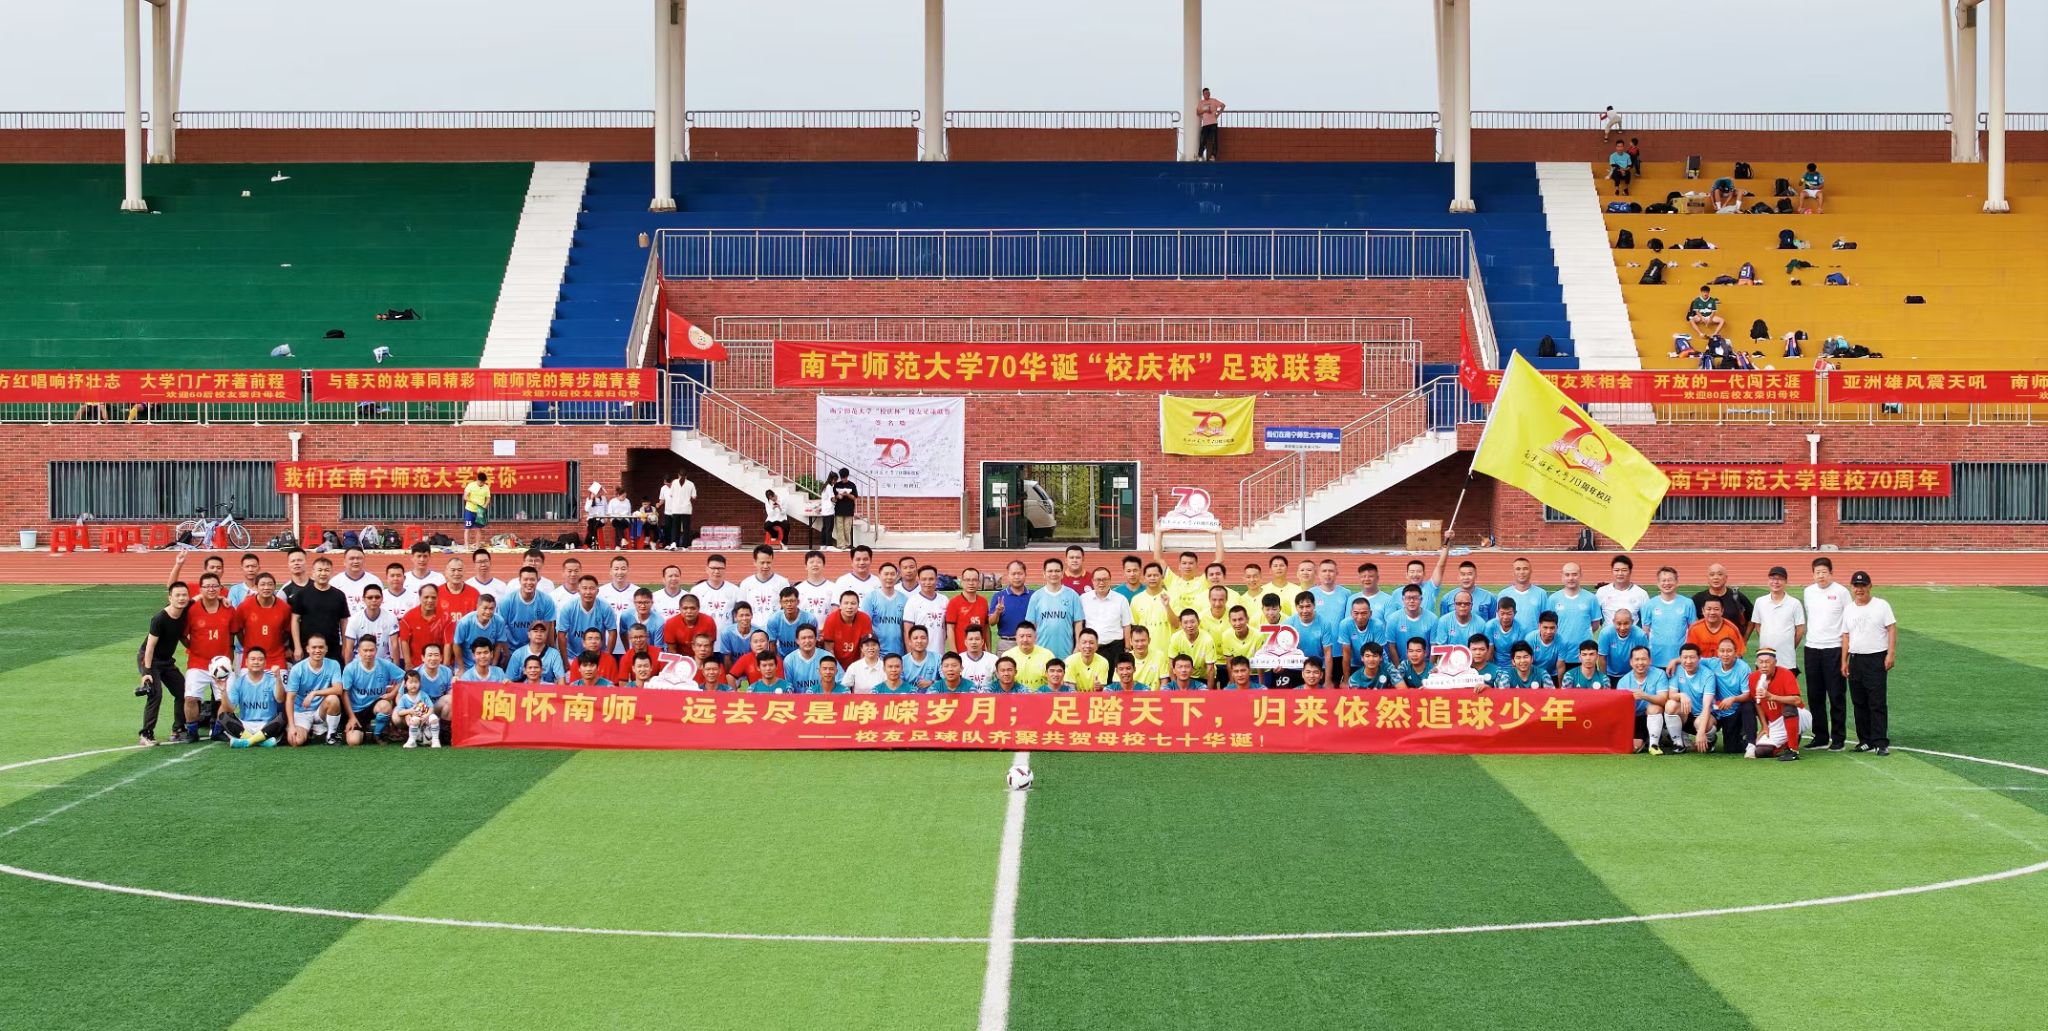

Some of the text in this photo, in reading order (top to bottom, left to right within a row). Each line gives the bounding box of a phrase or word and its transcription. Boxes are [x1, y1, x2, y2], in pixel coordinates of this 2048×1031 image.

[799, 351, 1341, 382] 南宁师范大学70华诞“校庆杯”足球联赛
[140, 373, 286, 389] 大学门广开著前程
[328, 373, 641, 389] 与春天的故事同精彩 随师院的舞步踏青春
[1654, 374, 1801, 389] 开放的一代闯天涯
[1661, 468, 1940, 491] 南宁师范大学建校70周年
[1041, 611, 1067, 620] NNNU
[209, 629, 219, 641] 14
[262, 625, 269, 636] 8
[1261, 626, 1298, 648] 70
[243, 701, 269, 710] NNNU
[481, 689, 1593, 730] 胸怀南师，远去尽是峥嵘岁月；足踏天下，归来依然追球少年。
